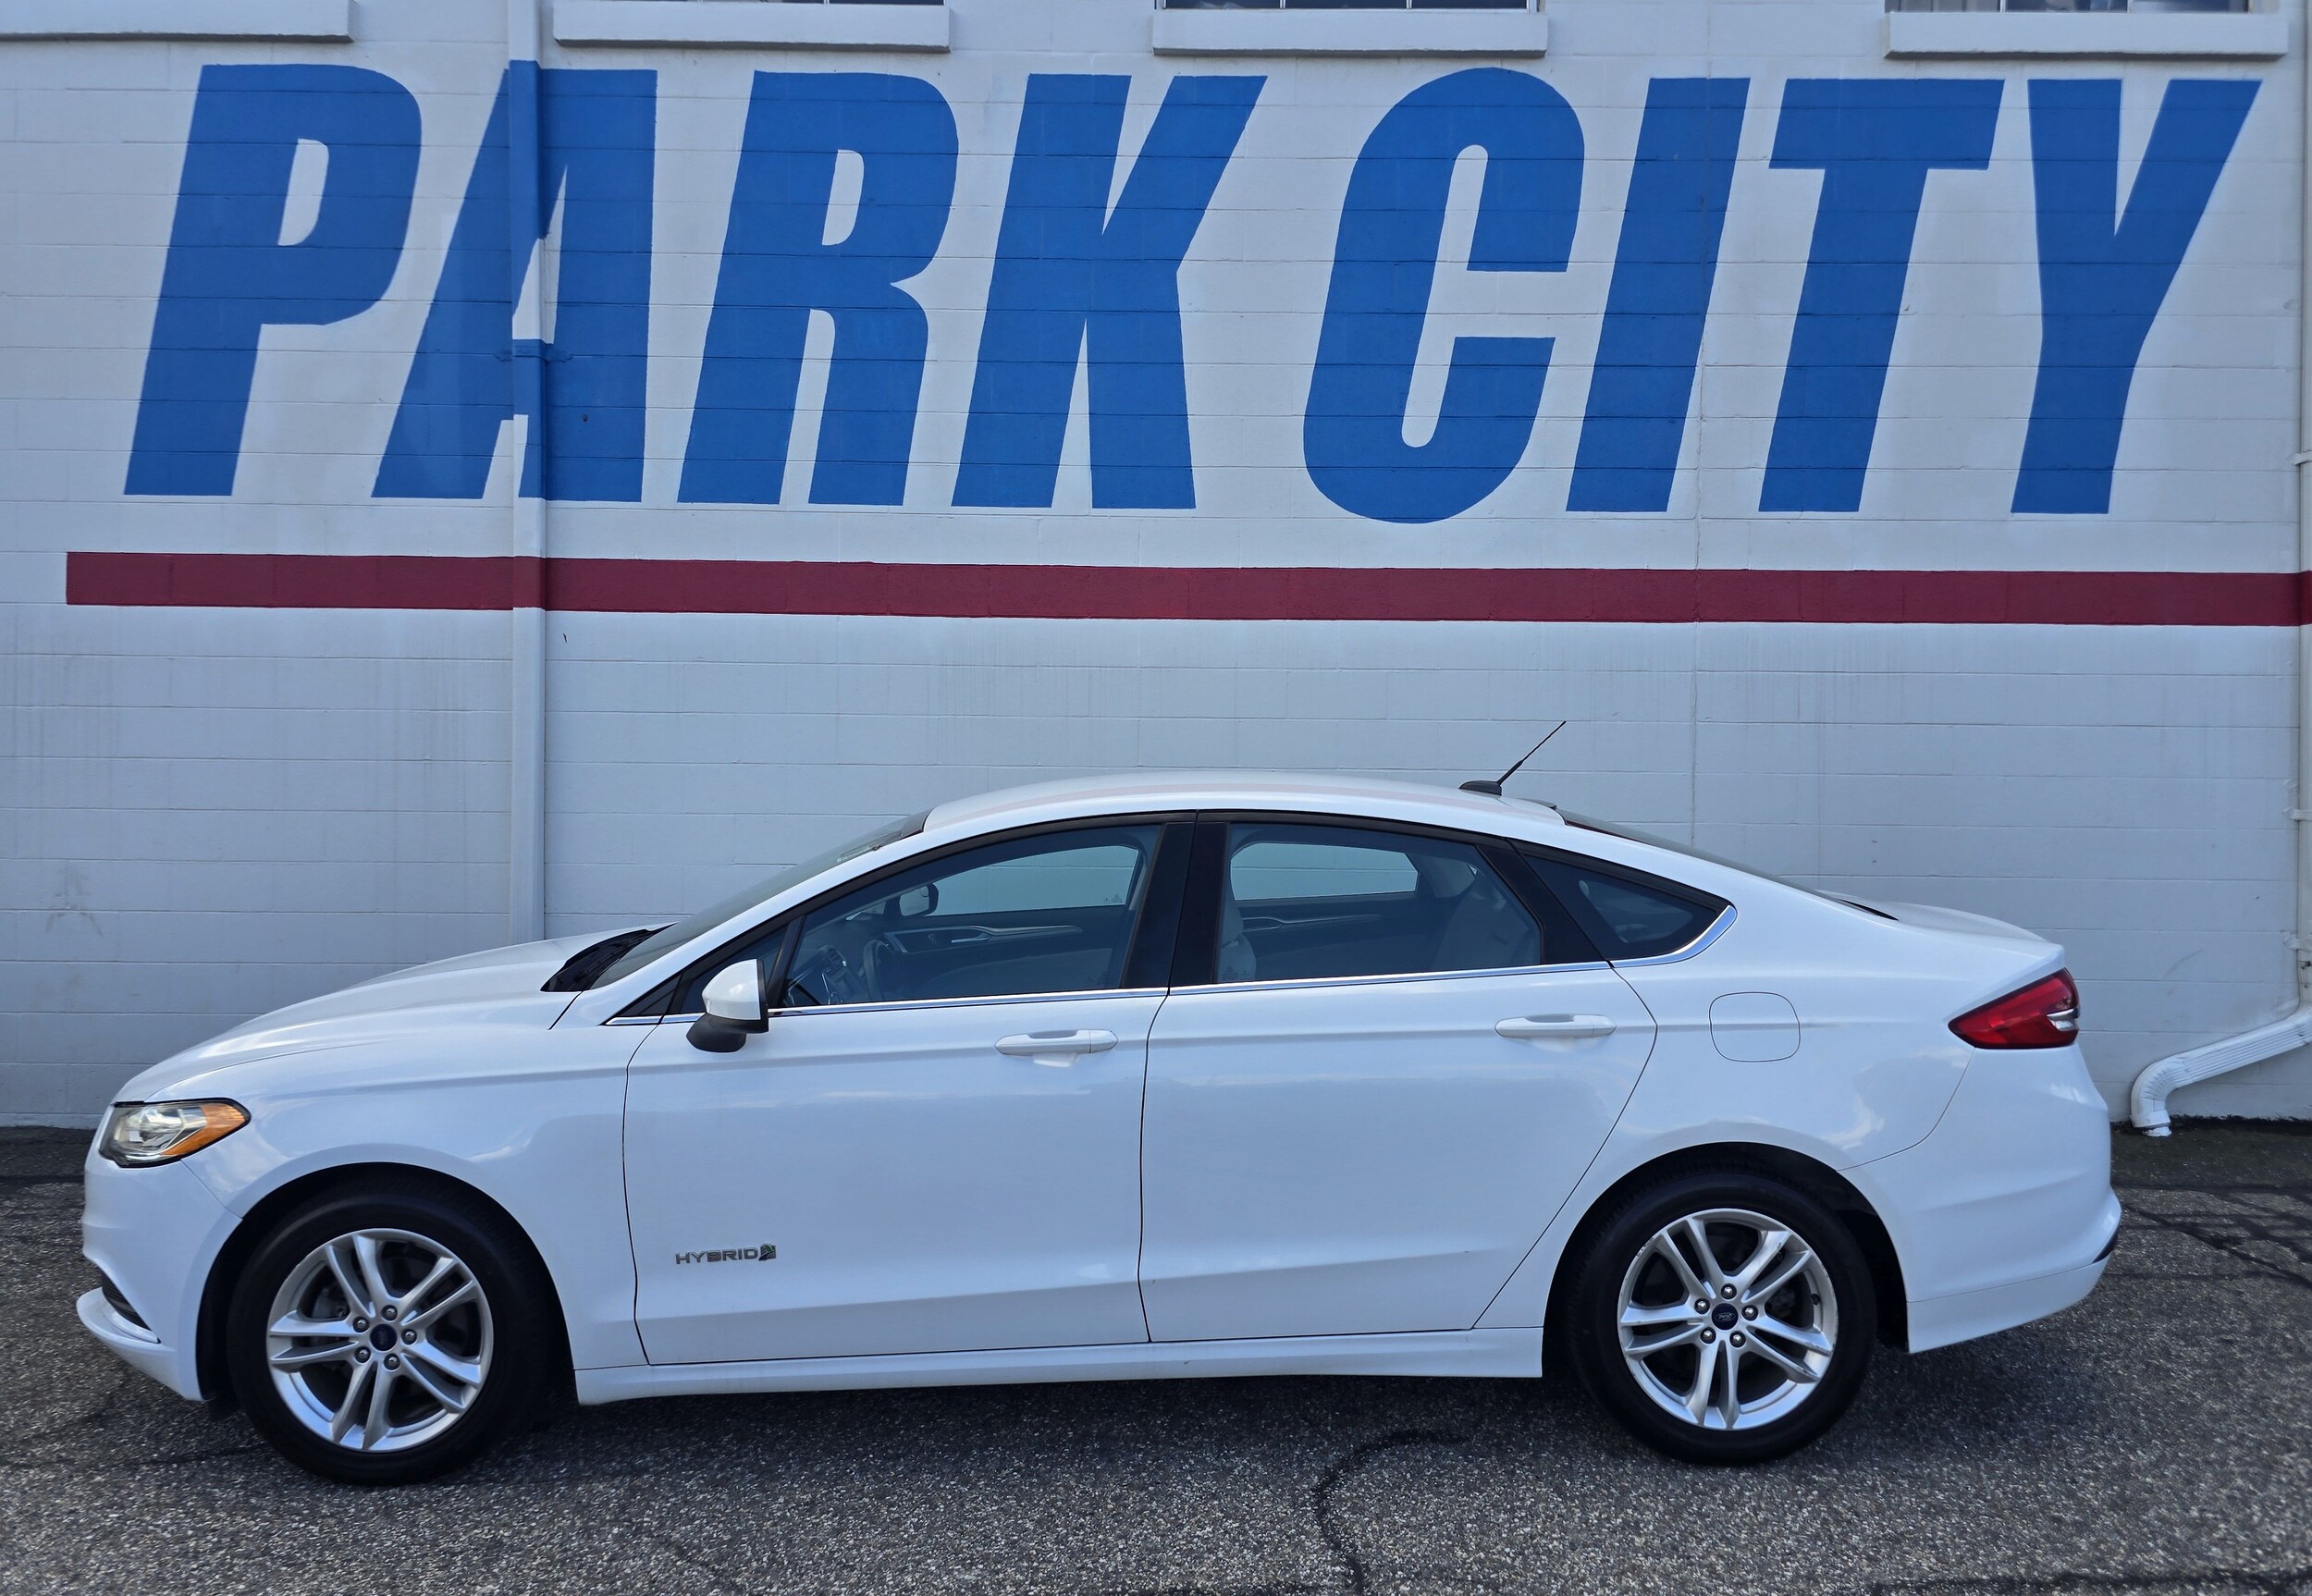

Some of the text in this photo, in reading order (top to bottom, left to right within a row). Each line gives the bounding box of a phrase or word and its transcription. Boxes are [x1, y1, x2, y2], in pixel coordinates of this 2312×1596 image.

[125, 60, 2261, 523] PARK CITY
[675, 1246, 758, 1265] HYBRID
